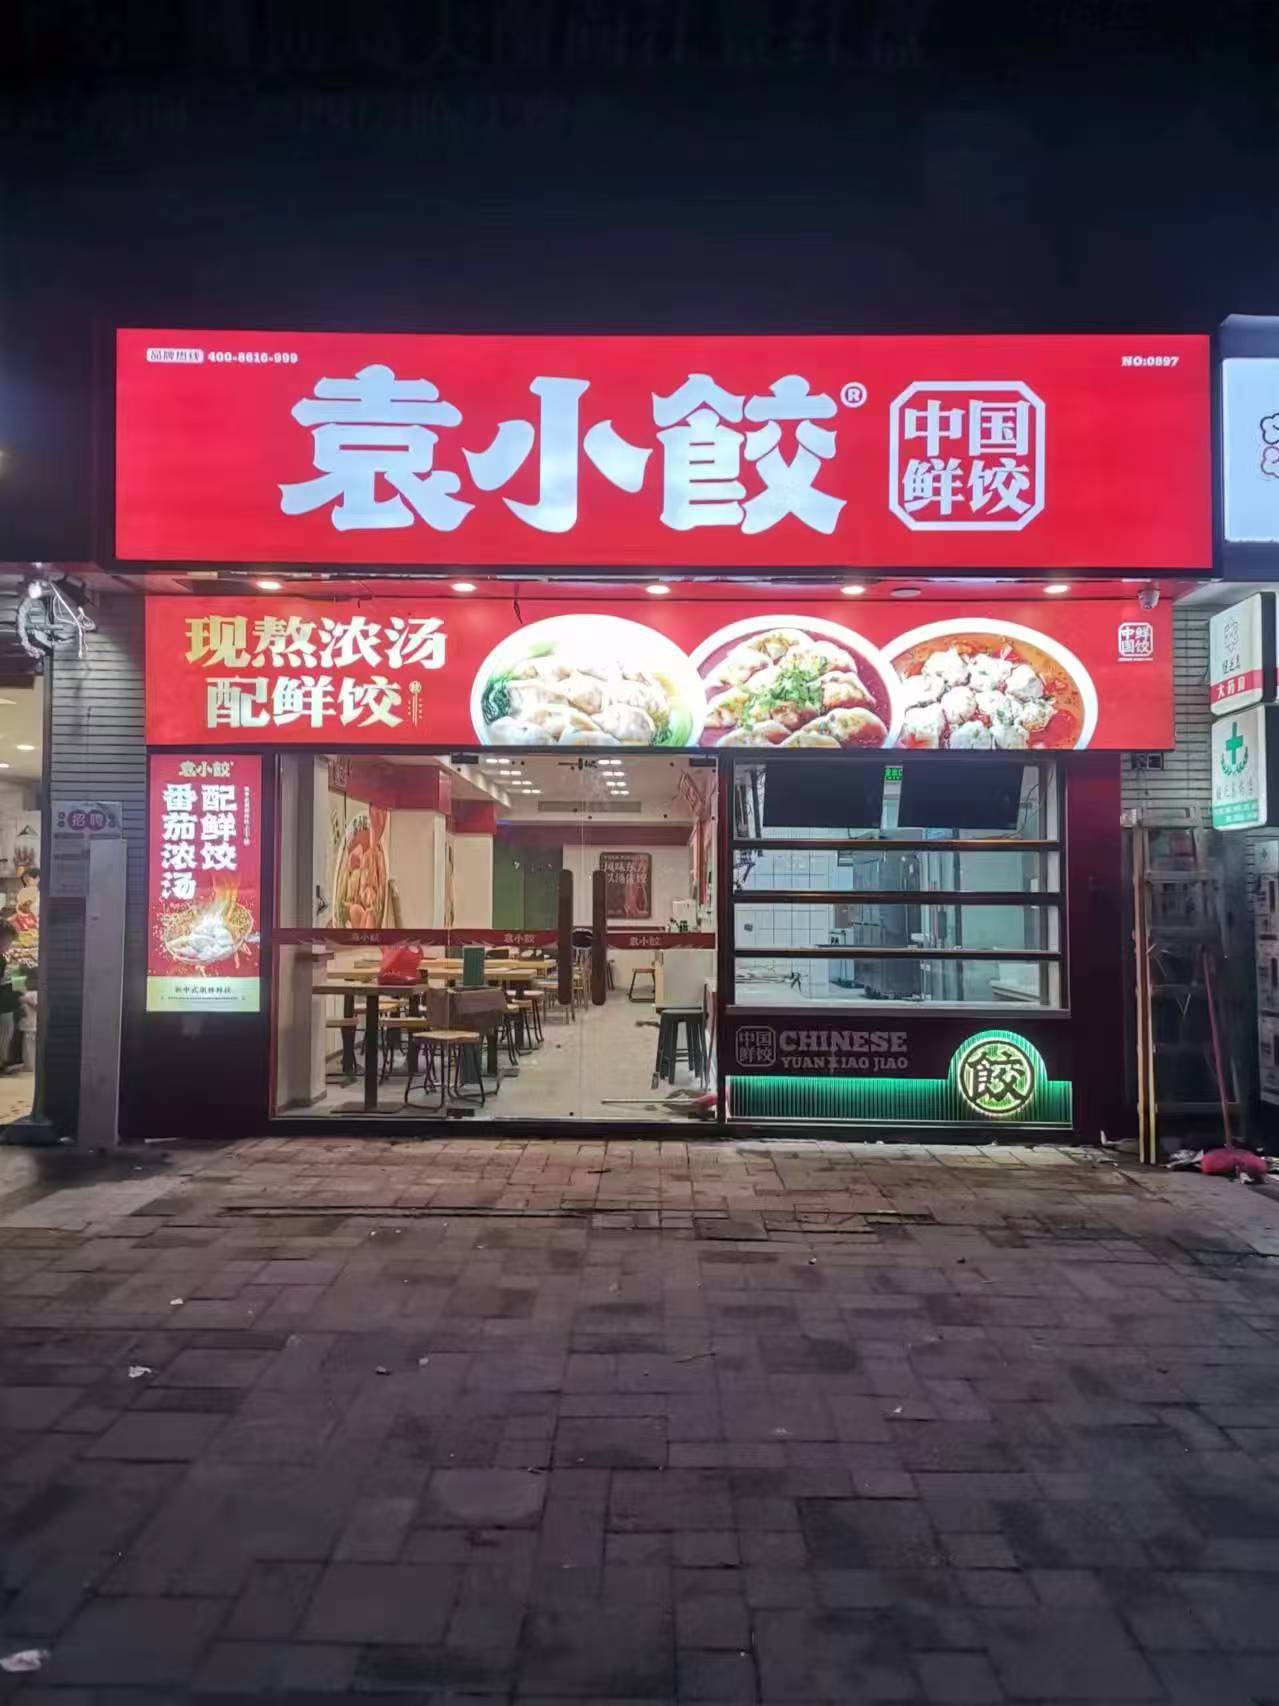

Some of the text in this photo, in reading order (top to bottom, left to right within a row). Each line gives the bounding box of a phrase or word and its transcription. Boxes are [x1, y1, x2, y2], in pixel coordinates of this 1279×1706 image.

[1121, 355, 1180, 368] NO:0897
[903, 399, 1031, 457] 中国
[901, 458, 1031, 516] 鲜饺
[184, 615, 448, 669] 现熬浓汤
[205, 675, 404, 729] 配鲜饺
[161, 783, 198, 900] 番茄浓汤
[200, 784, 238, 871] 配鲜饺
[779, 1030, 908, 1053] CHINESE
